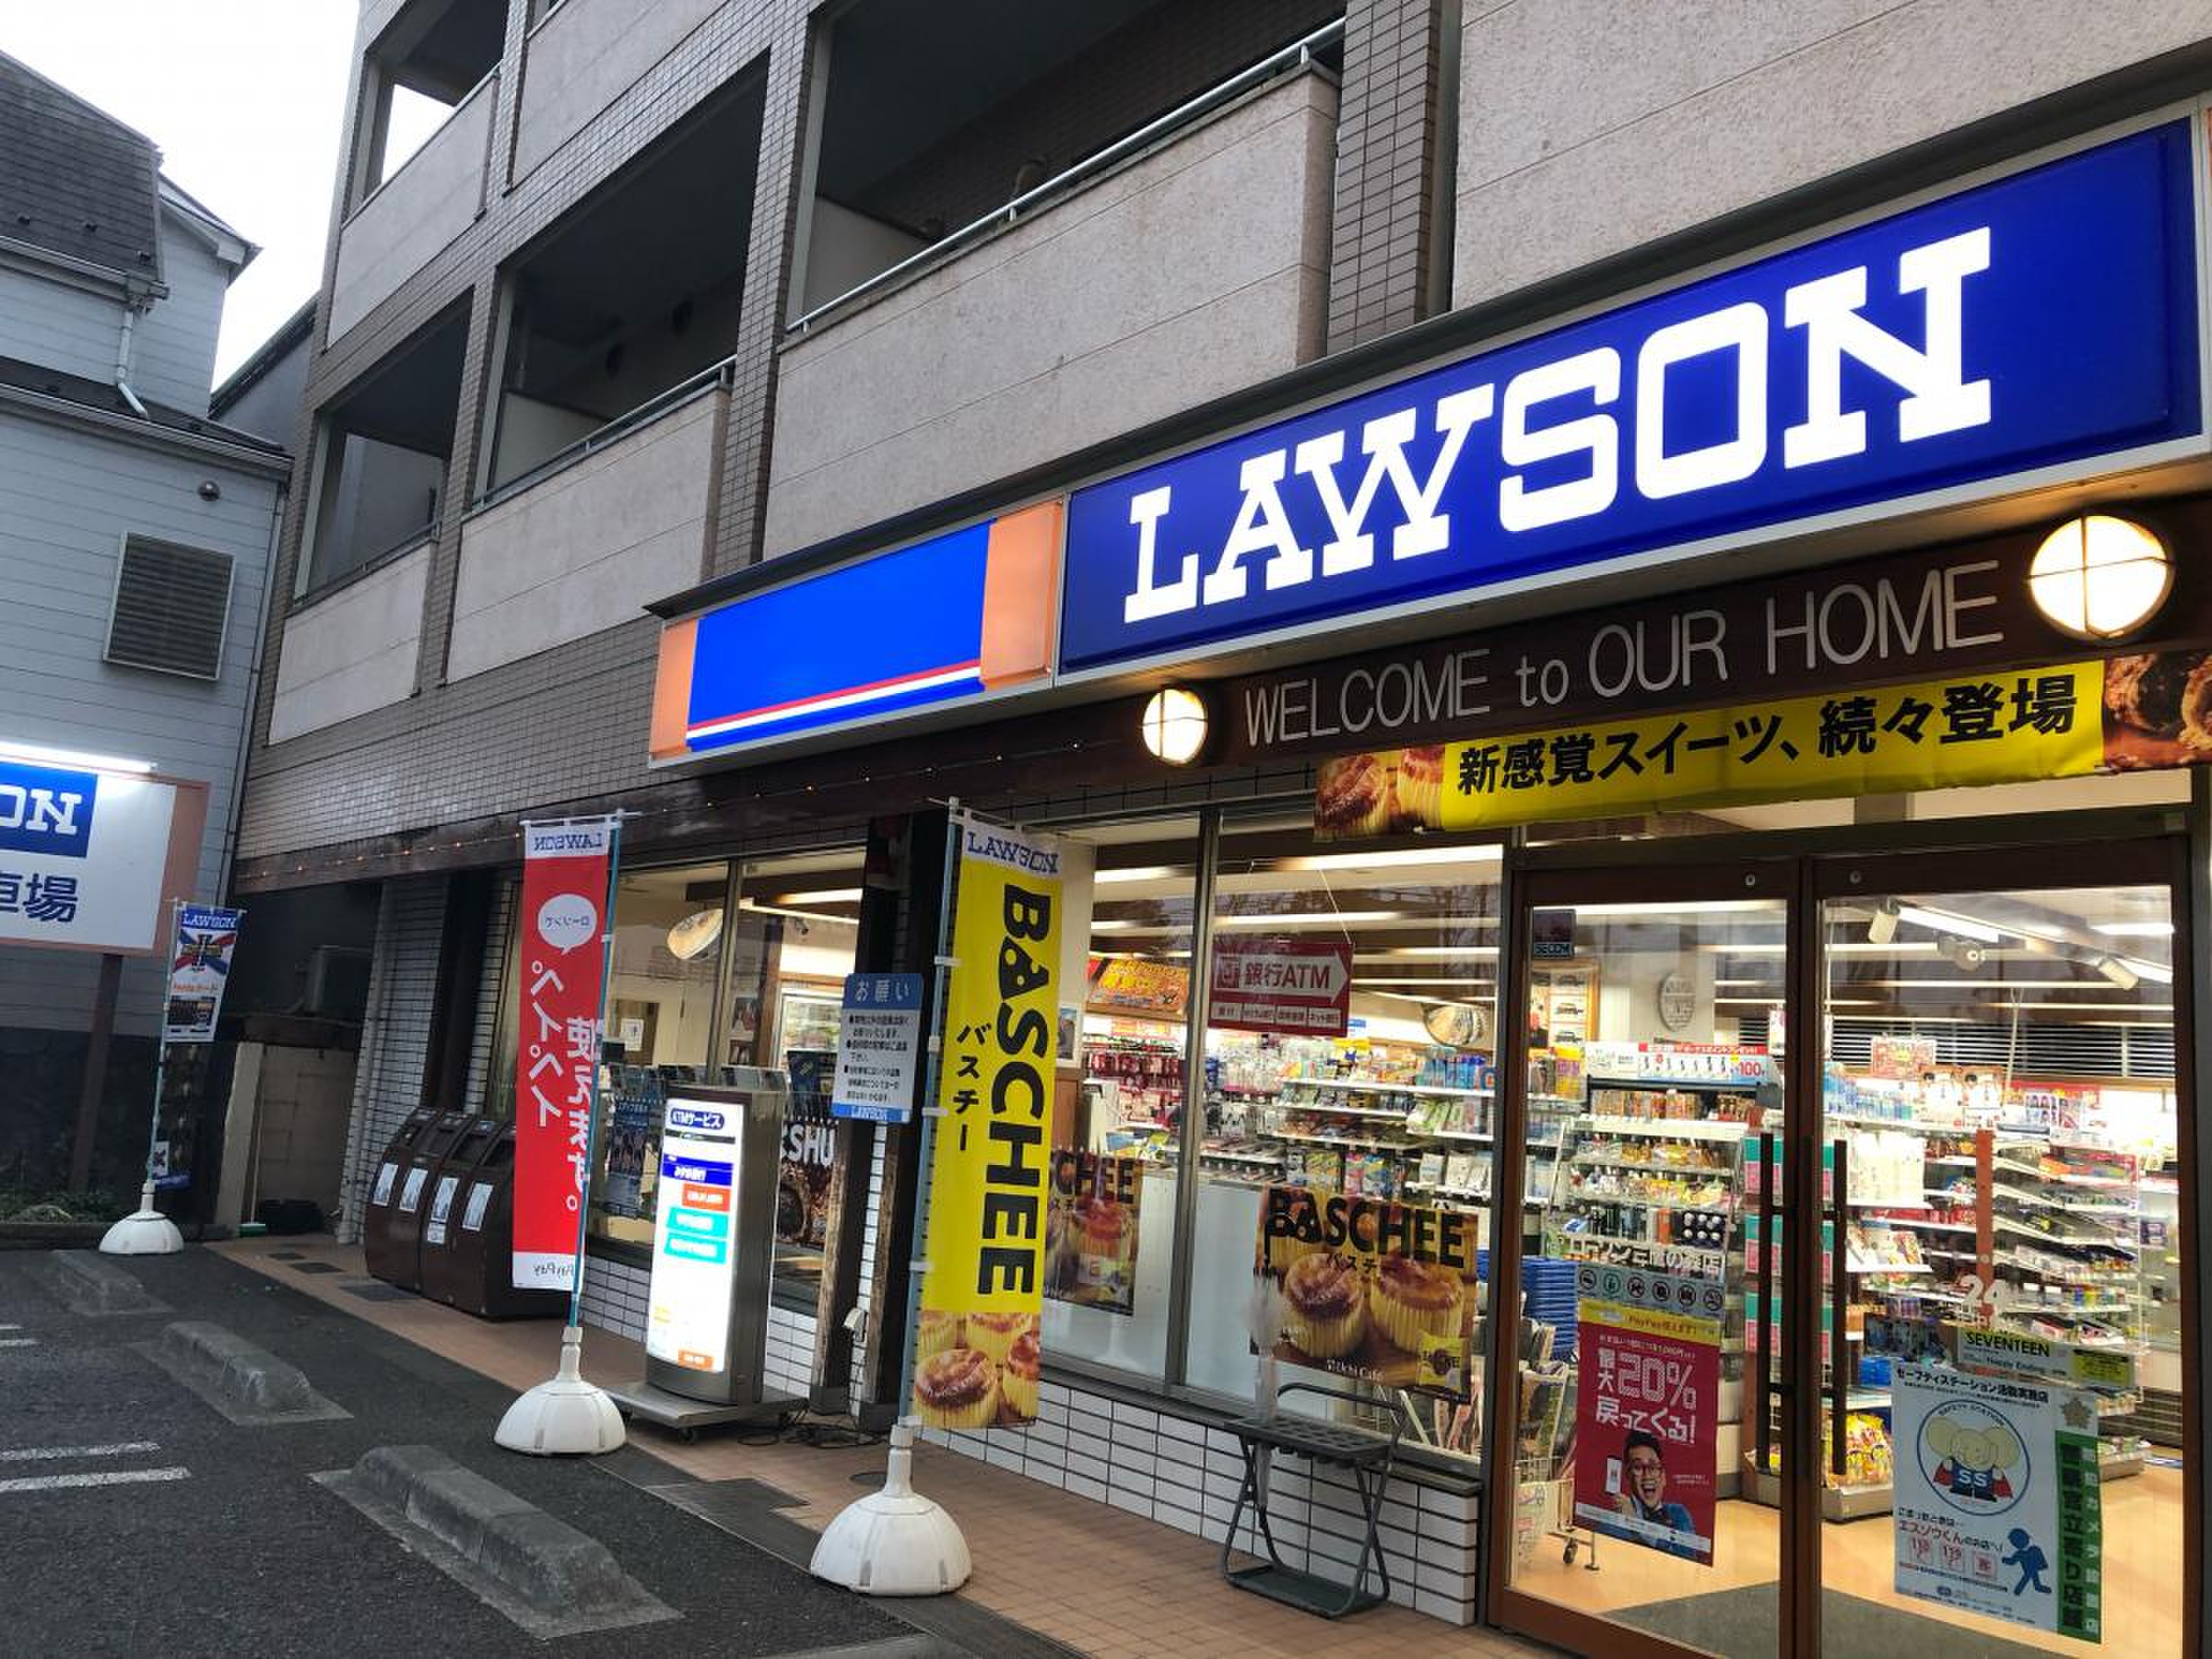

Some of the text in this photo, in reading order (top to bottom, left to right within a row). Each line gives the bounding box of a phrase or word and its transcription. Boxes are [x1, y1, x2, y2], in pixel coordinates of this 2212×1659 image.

[1124, 226, 1992, 624] LAWSON
[1245, 559, 2004, 747] WELCOME to OUR HOME
[1457, 674, 2077, 796] 新感覚スイーツ、続々登場
[968, 830, 1060, 874] LAWSON
[855, 979, 910, 1003] お願い
[1244, 962, 1329, 989] 銀行ATM
[954, 1022, 992, 1151] バスチー
[978, 883, 1051, 1294] BASCHEE
[1265, 1187, 1465, 1269] BASCHEE
[1965, 1330, 2051, 1357] SEVENTEEN
[1618, 1351, 1697, 1410] 20%
[1958, 1469, 1988, 1488] SS
